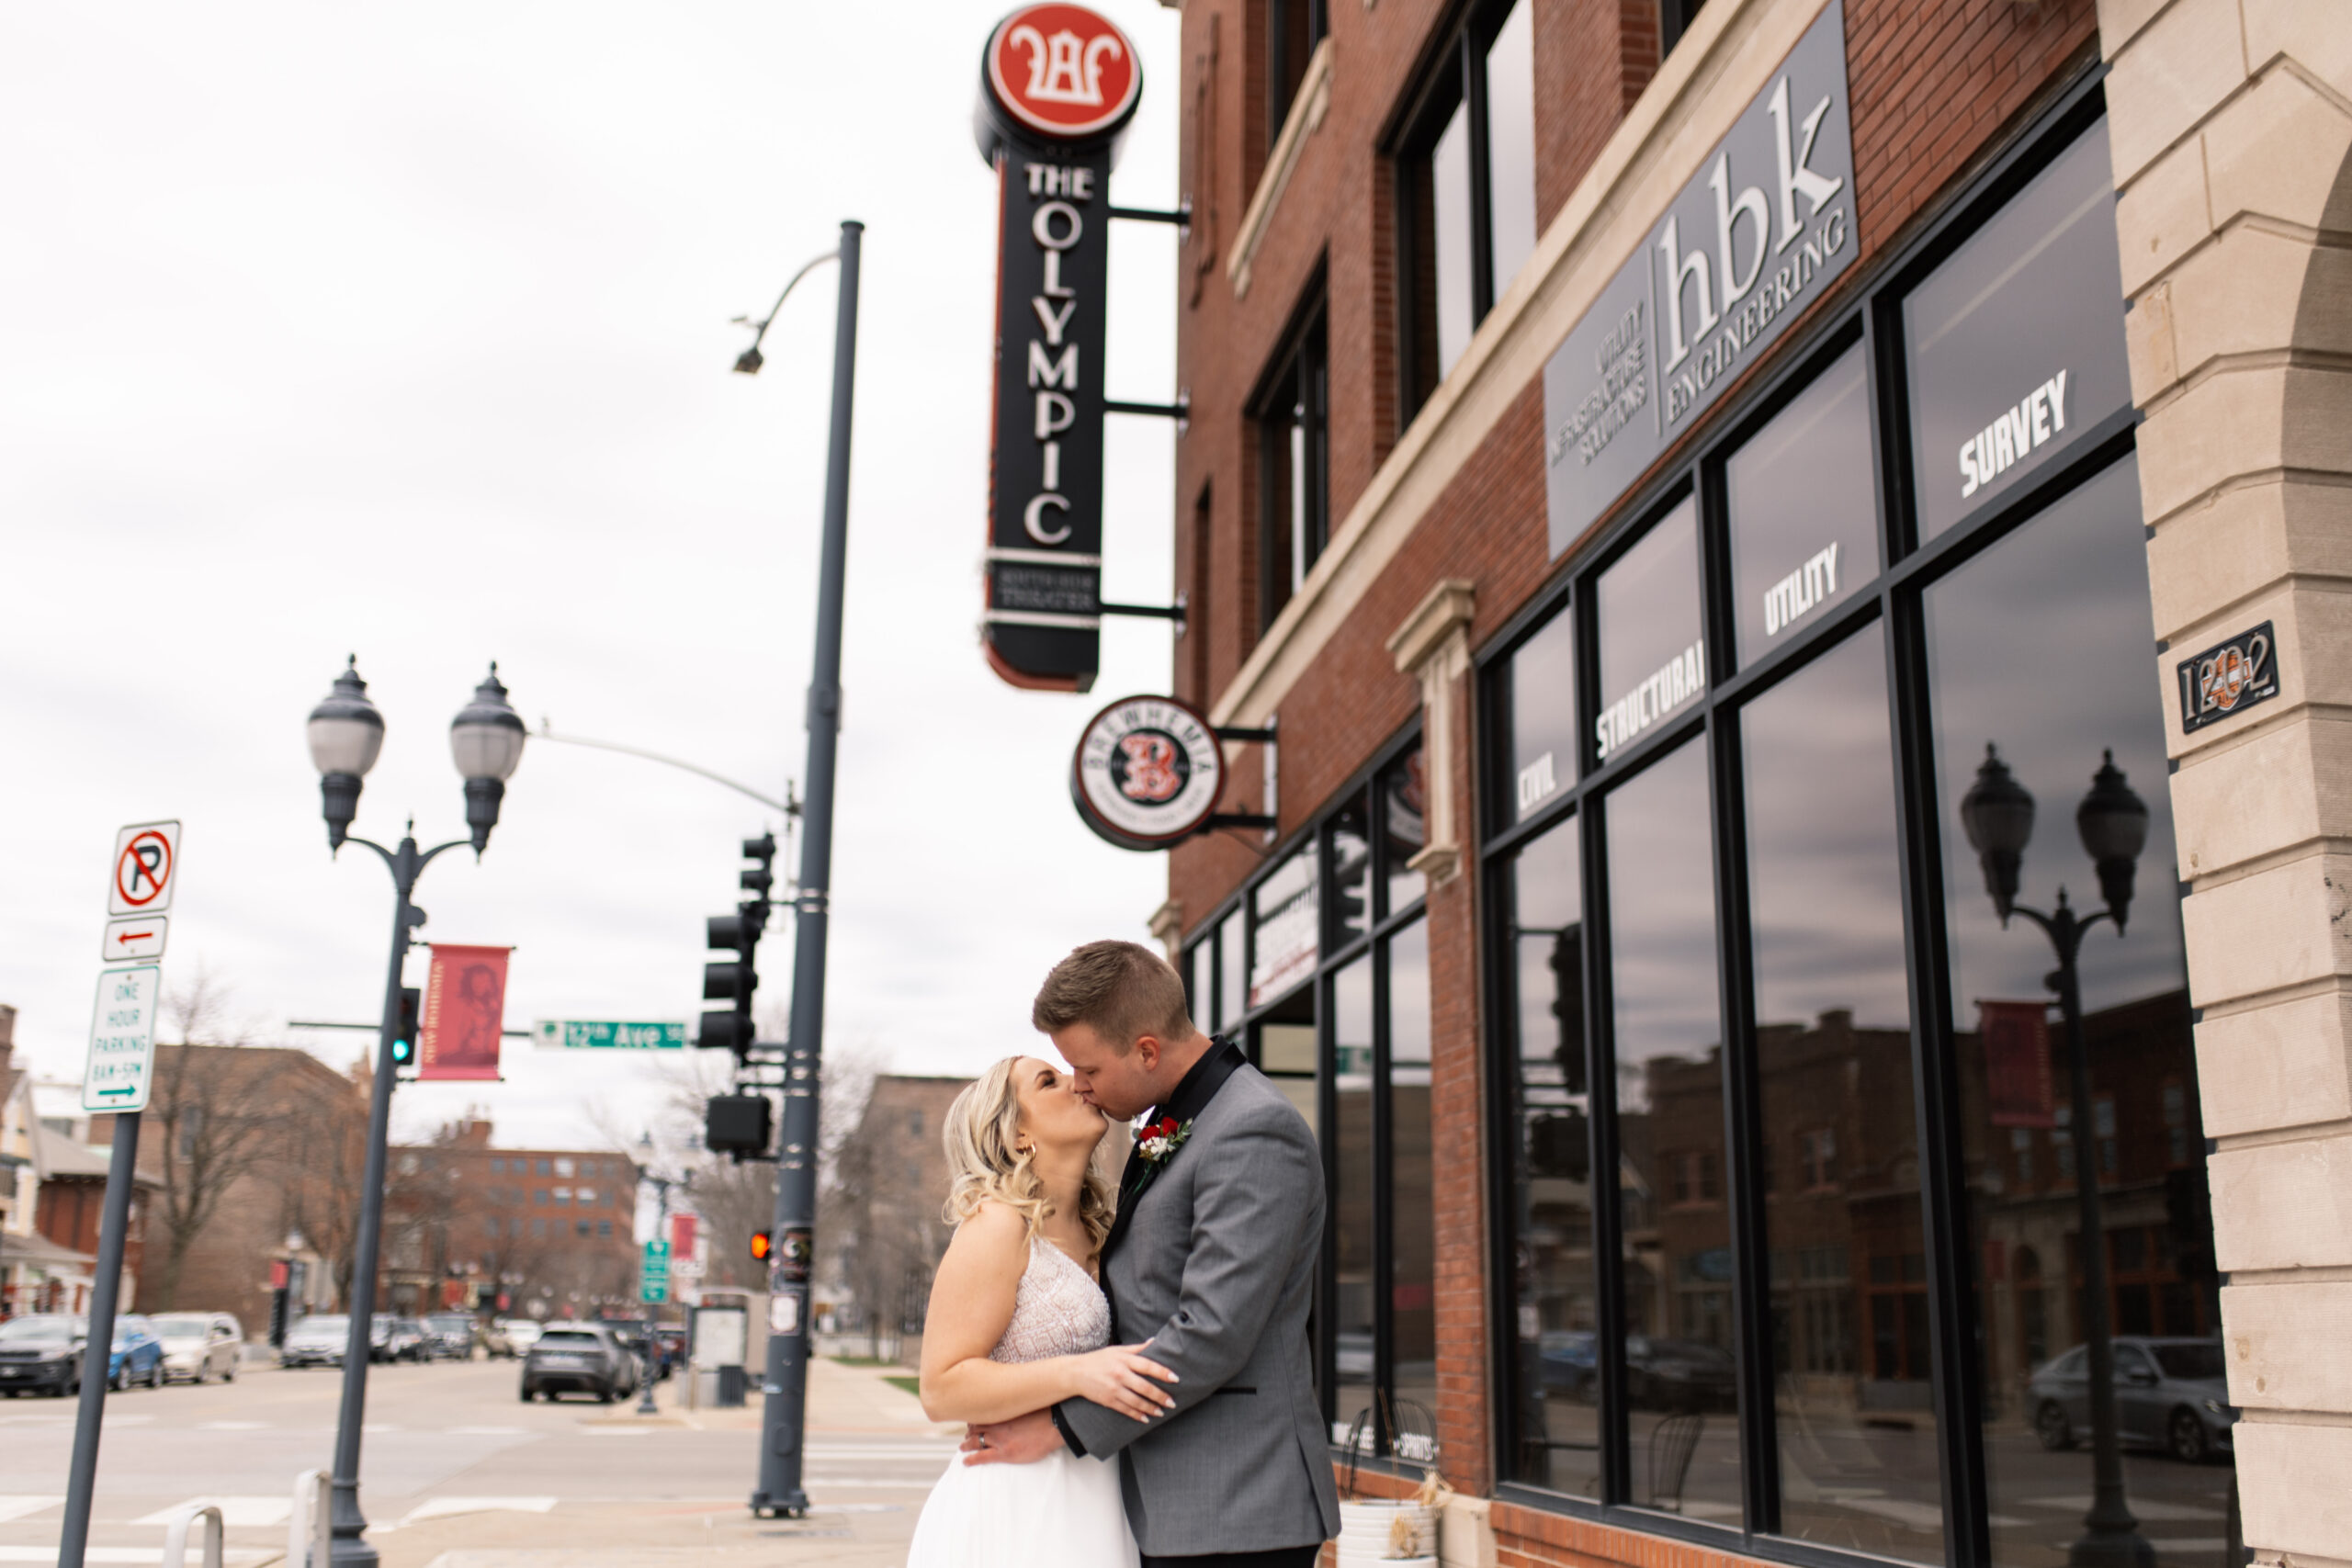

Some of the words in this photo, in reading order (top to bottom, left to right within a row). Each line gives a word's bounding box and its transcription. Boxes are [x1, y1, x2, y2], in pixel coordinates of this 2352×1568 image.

[1023, 162, 1094, 200] THE
[1658, 73, 1844, 377] hbk
[1595, 299, 1645, 376] UTILITY
[1666, 208, 1846, 425] ENGINEERING
[1023, 200, 1083, 546] OLYMPIC
[1580, 373, 1648, 467] SOLUTIONS
[1959, 367, 2067, 499] SURVEY
[1763, 540, 1838, 637] UTILITY
[2181, 634, 2269, 721] 1202
[1082, 702, 1215, 774] BREWHEMIA
[1517, 750, 1556, 811] CIVIL
[107, 1008, 141, 1028] HOUR
[115, 982, 140, 1002] ONE
[94, 1033, 147, 1054] PARKING
[613, 1021, 662, 1048] Ave
